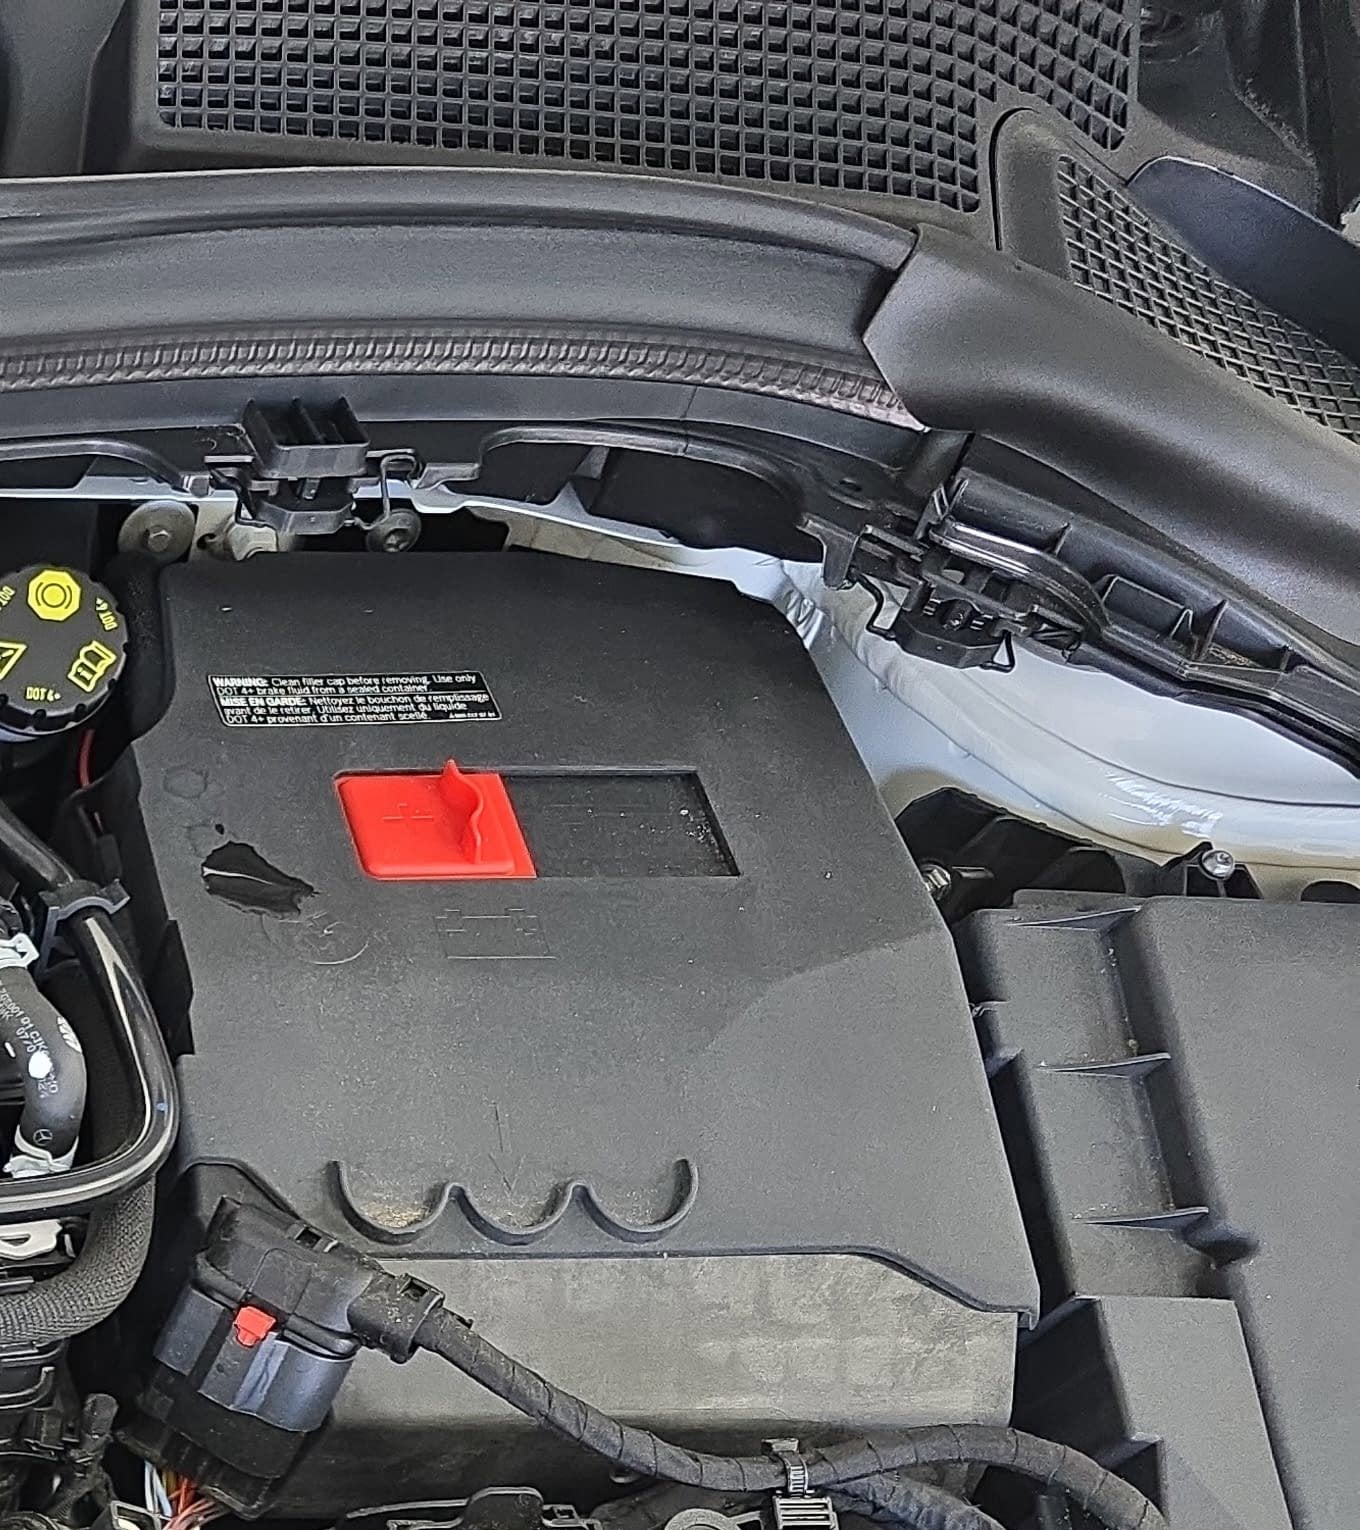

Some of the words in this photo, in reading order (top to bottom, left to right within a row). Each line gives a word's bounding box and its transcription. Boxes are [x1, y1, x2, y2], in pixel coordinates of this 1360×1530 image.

[98, 611, 118, 631] DOT
[212, 677, 269, 687] WARNING:
[271, 677, 301, 687] Clean
[302, 677, 324, 686] filler
[326, 678, 346, 687] cap
[346, 676, 379, 685] before
[432, 675, 453, 683] Use
[455, 674, 476, 684] only
[26, 687, 47, 700] DOT
[216, 687, 238, 696] DOT
[241, 687, 255, 695] 4+
[256, 687, 286, 695] brake
[287, 686, 311, 695] fluid
[311, 686, 337, 694] from
[346, 685, 379, 693] sealed
[221, 697, 248, 706] MISE
[248, 697, 265, 706] EN
[265, 696, 307, 706] GARDE:
[308, 696, 353, 707] Nettoyez
[355, 695, 365, 704] le
[367, 695, 411, 704] bouchon
[413, 694, 427, 703] de
[428, 694, 489, 703] remplissage
[224, 707, 251, 715] avant
[253, 707, 267, 715] de
[268, 706, 278, 714] le
[316, 705, 353, 714] Utilisez
[356, 704, 416, 713] uniquement
[418, 703, 432, 712] du
[433, 702, 468, 712] liquide
[226, 716, 248, 724] DOT
[250, 715, 265, 723] 4+
[266, 715, 319, 724] provenant
[320, 713, 343, 722] d'un
[344, 712, 396, 721] contenant
